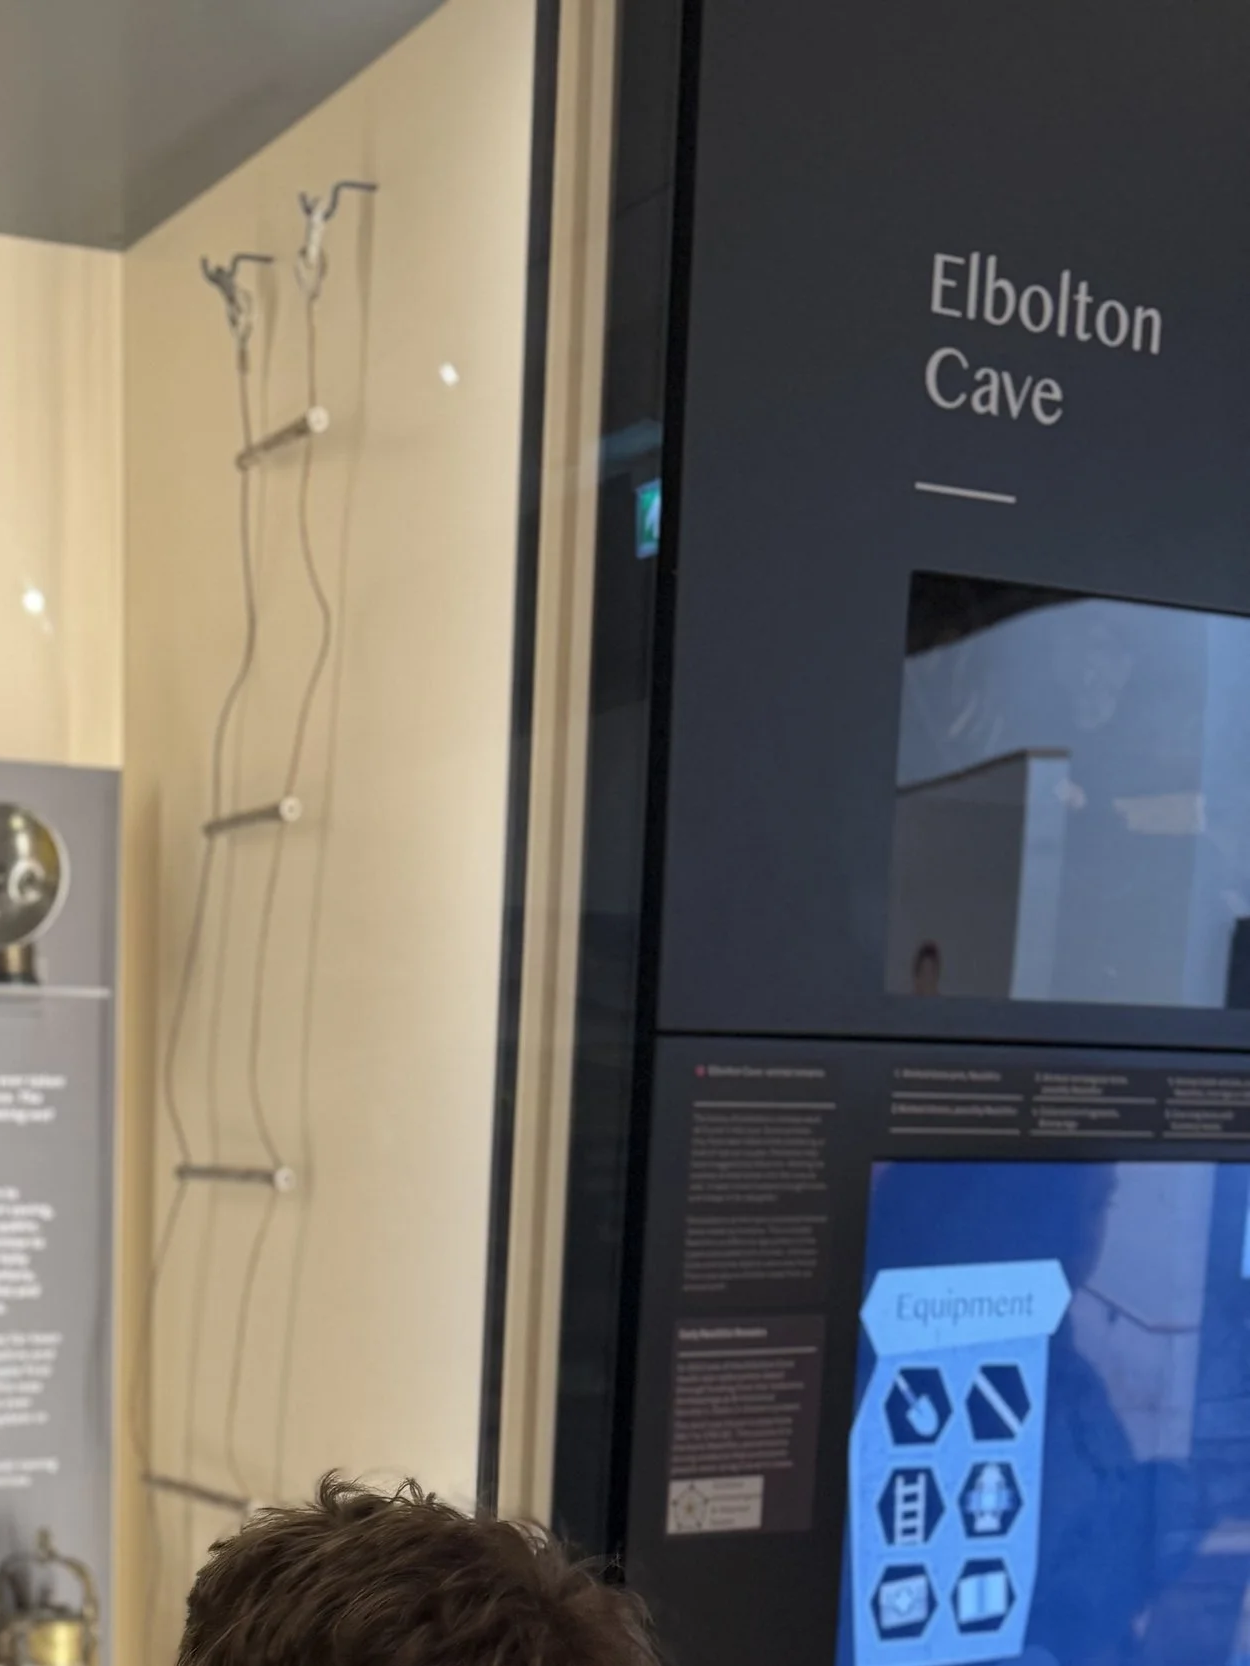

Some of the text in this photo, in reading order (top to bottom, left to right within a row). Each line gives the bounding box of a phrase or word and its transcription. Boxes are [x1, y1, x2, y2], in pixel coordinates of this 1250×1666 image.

[931, 251, 1162, 355] Elbolton
[925, 347, 1063, 425] Cave
[894, 1287, 1035, 1327] Equipment
